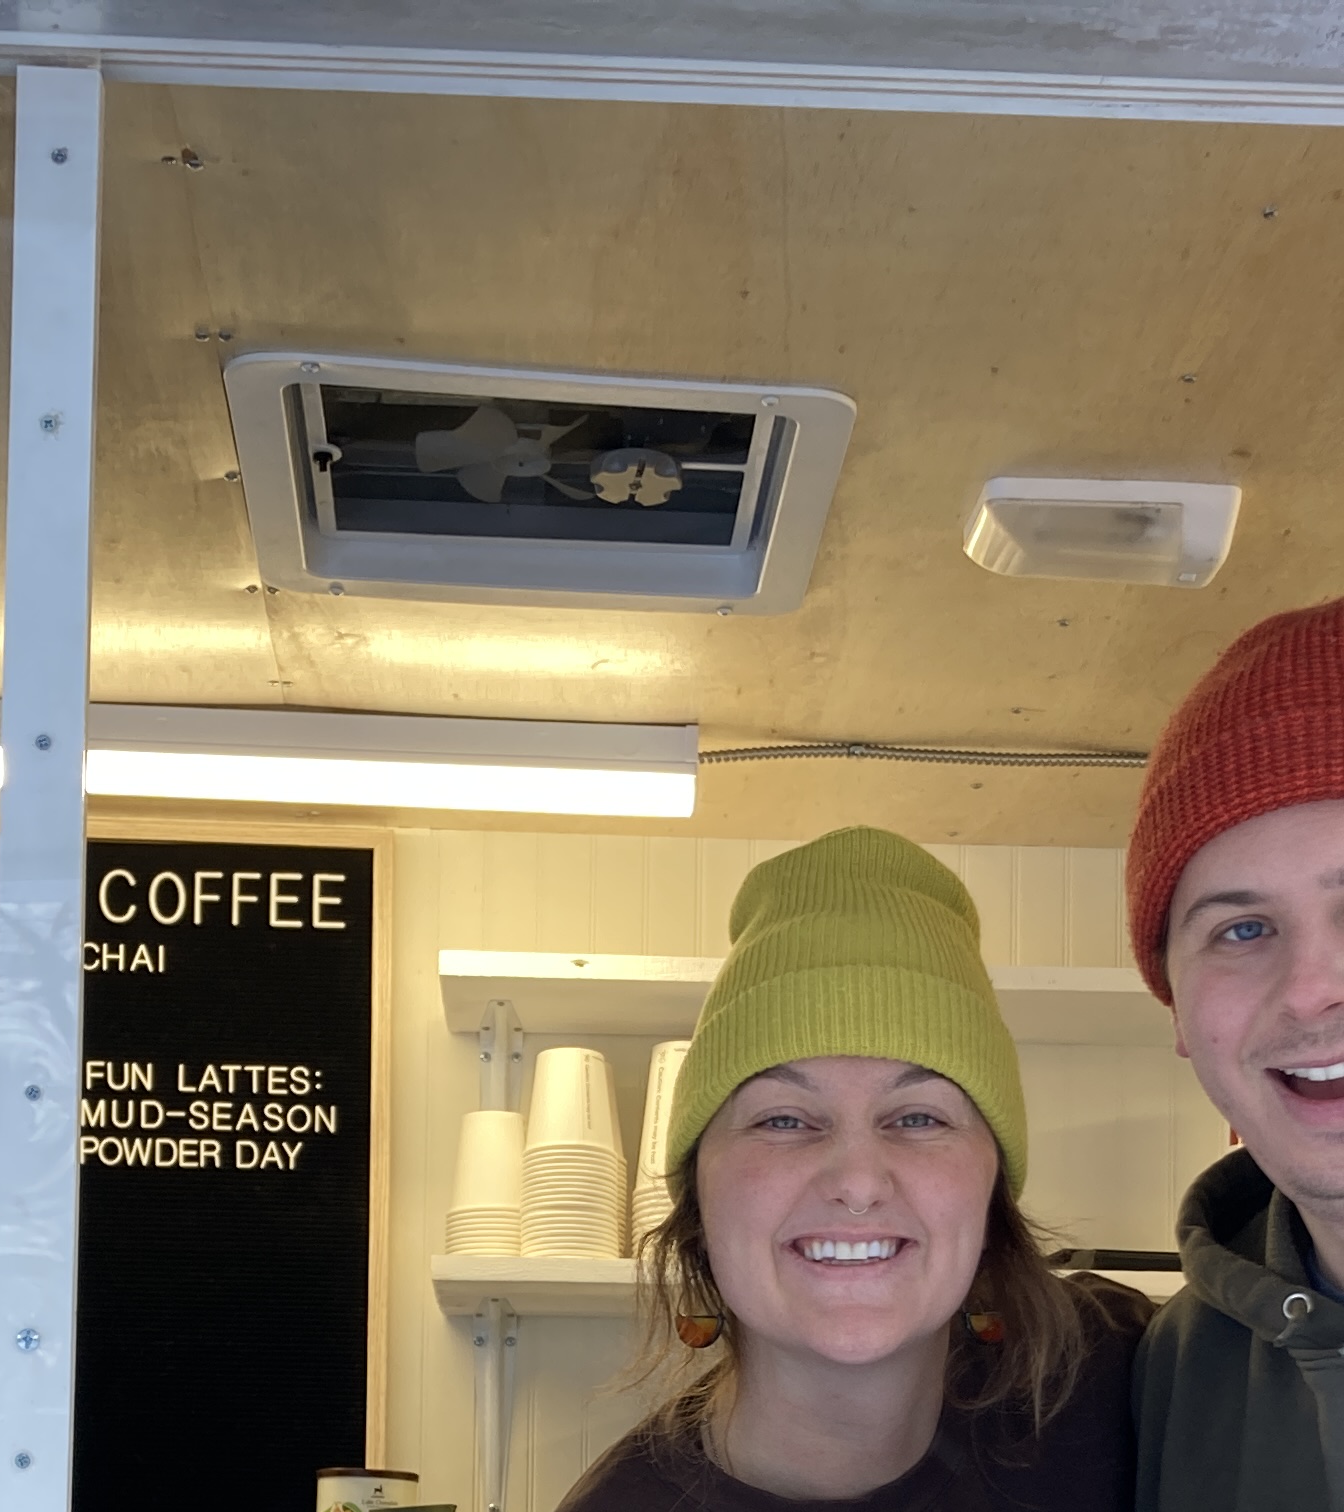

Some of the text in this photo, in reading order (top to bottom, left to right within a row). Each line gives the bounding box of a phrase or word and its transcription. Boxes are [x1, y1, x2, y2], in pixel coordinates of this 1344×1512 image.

[98, 869, 346, 930] COFFEE
[81, 942, 167, 974] CHAI
[84, 1060, 324, 1095] FUN LATTES:
[79, 1102, 337, 1134] MUD-SEASON
[78, 1137, 303, 1171] POWDER DAY
